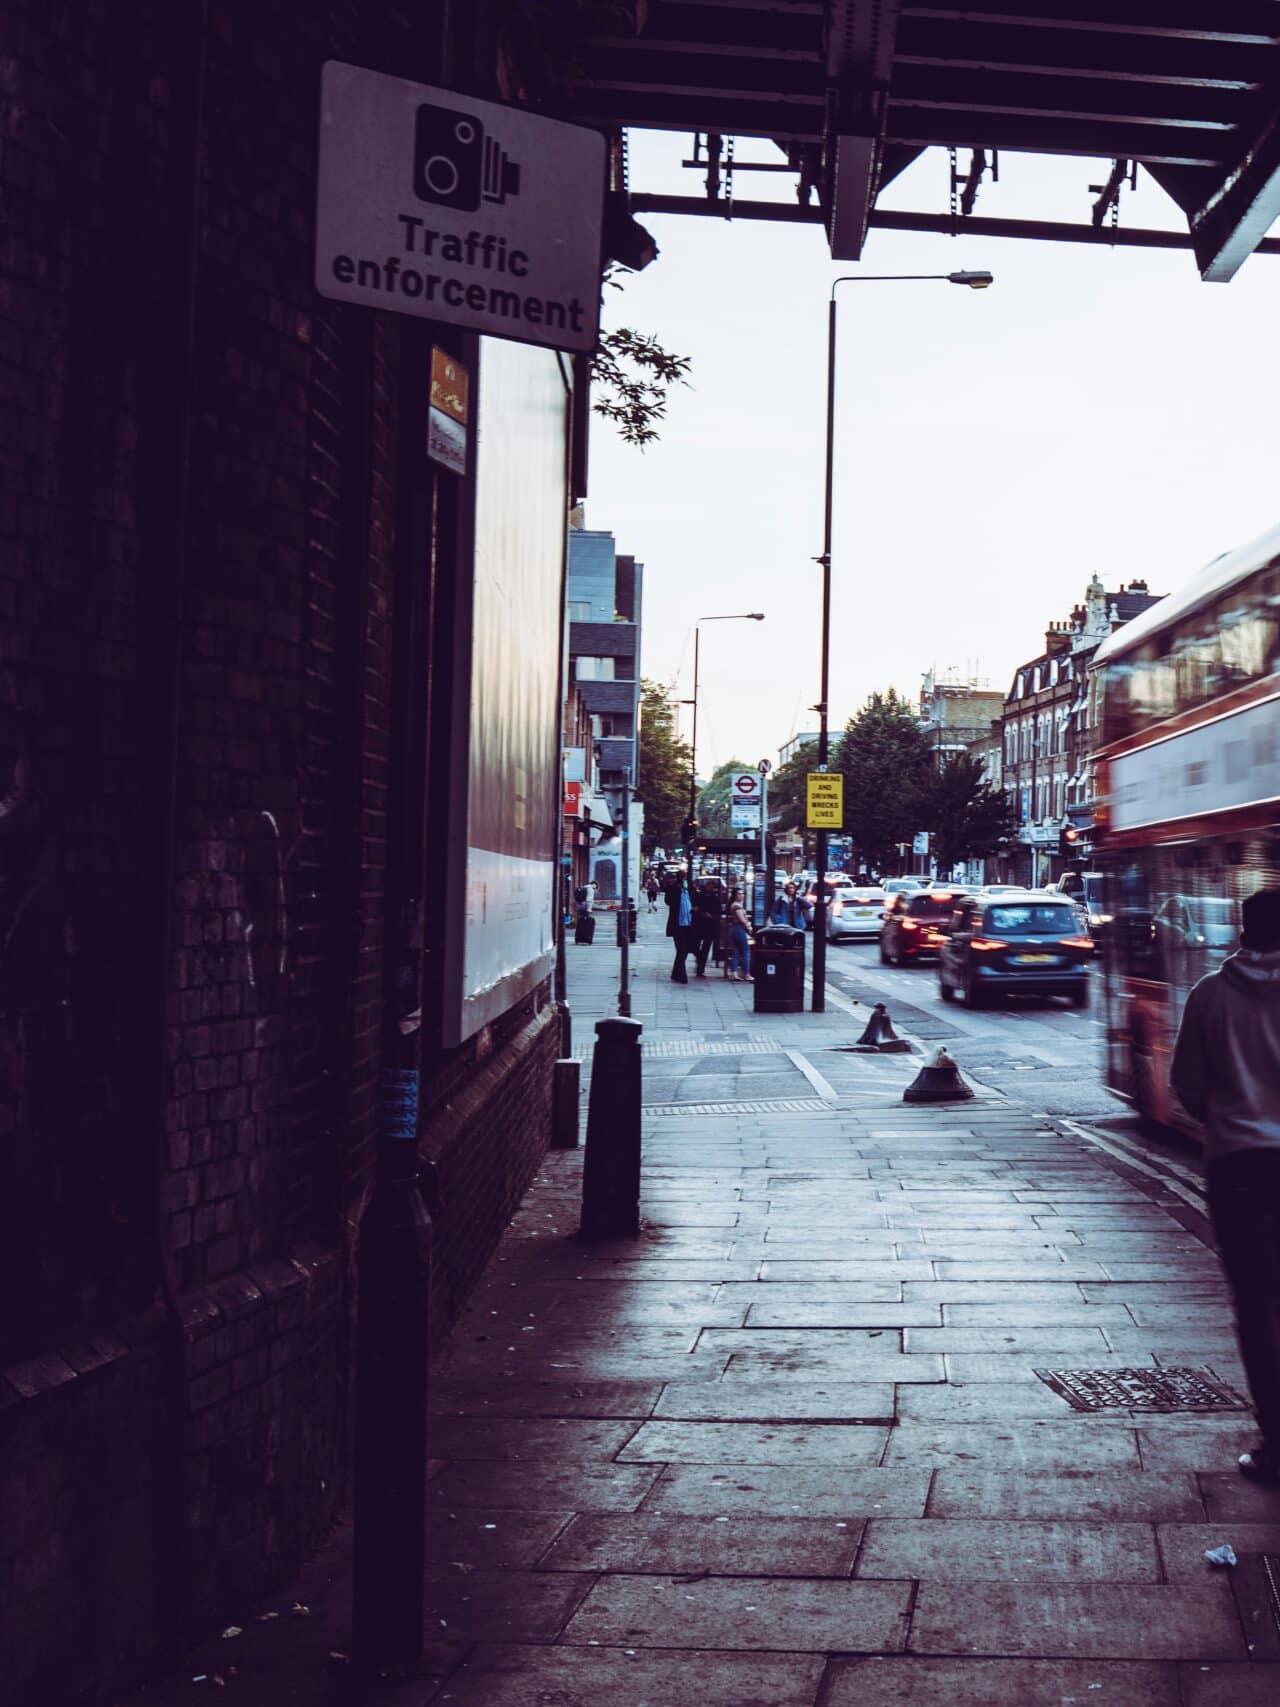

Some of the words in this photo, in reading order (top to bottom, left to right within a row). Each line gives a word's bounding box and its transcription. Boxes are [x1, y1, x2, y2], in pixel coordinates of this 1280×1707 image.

[398, 213, 530, 278] Traffic
[332, 253, 585, 334] enforcement
[760, 761, 770, 773] N
